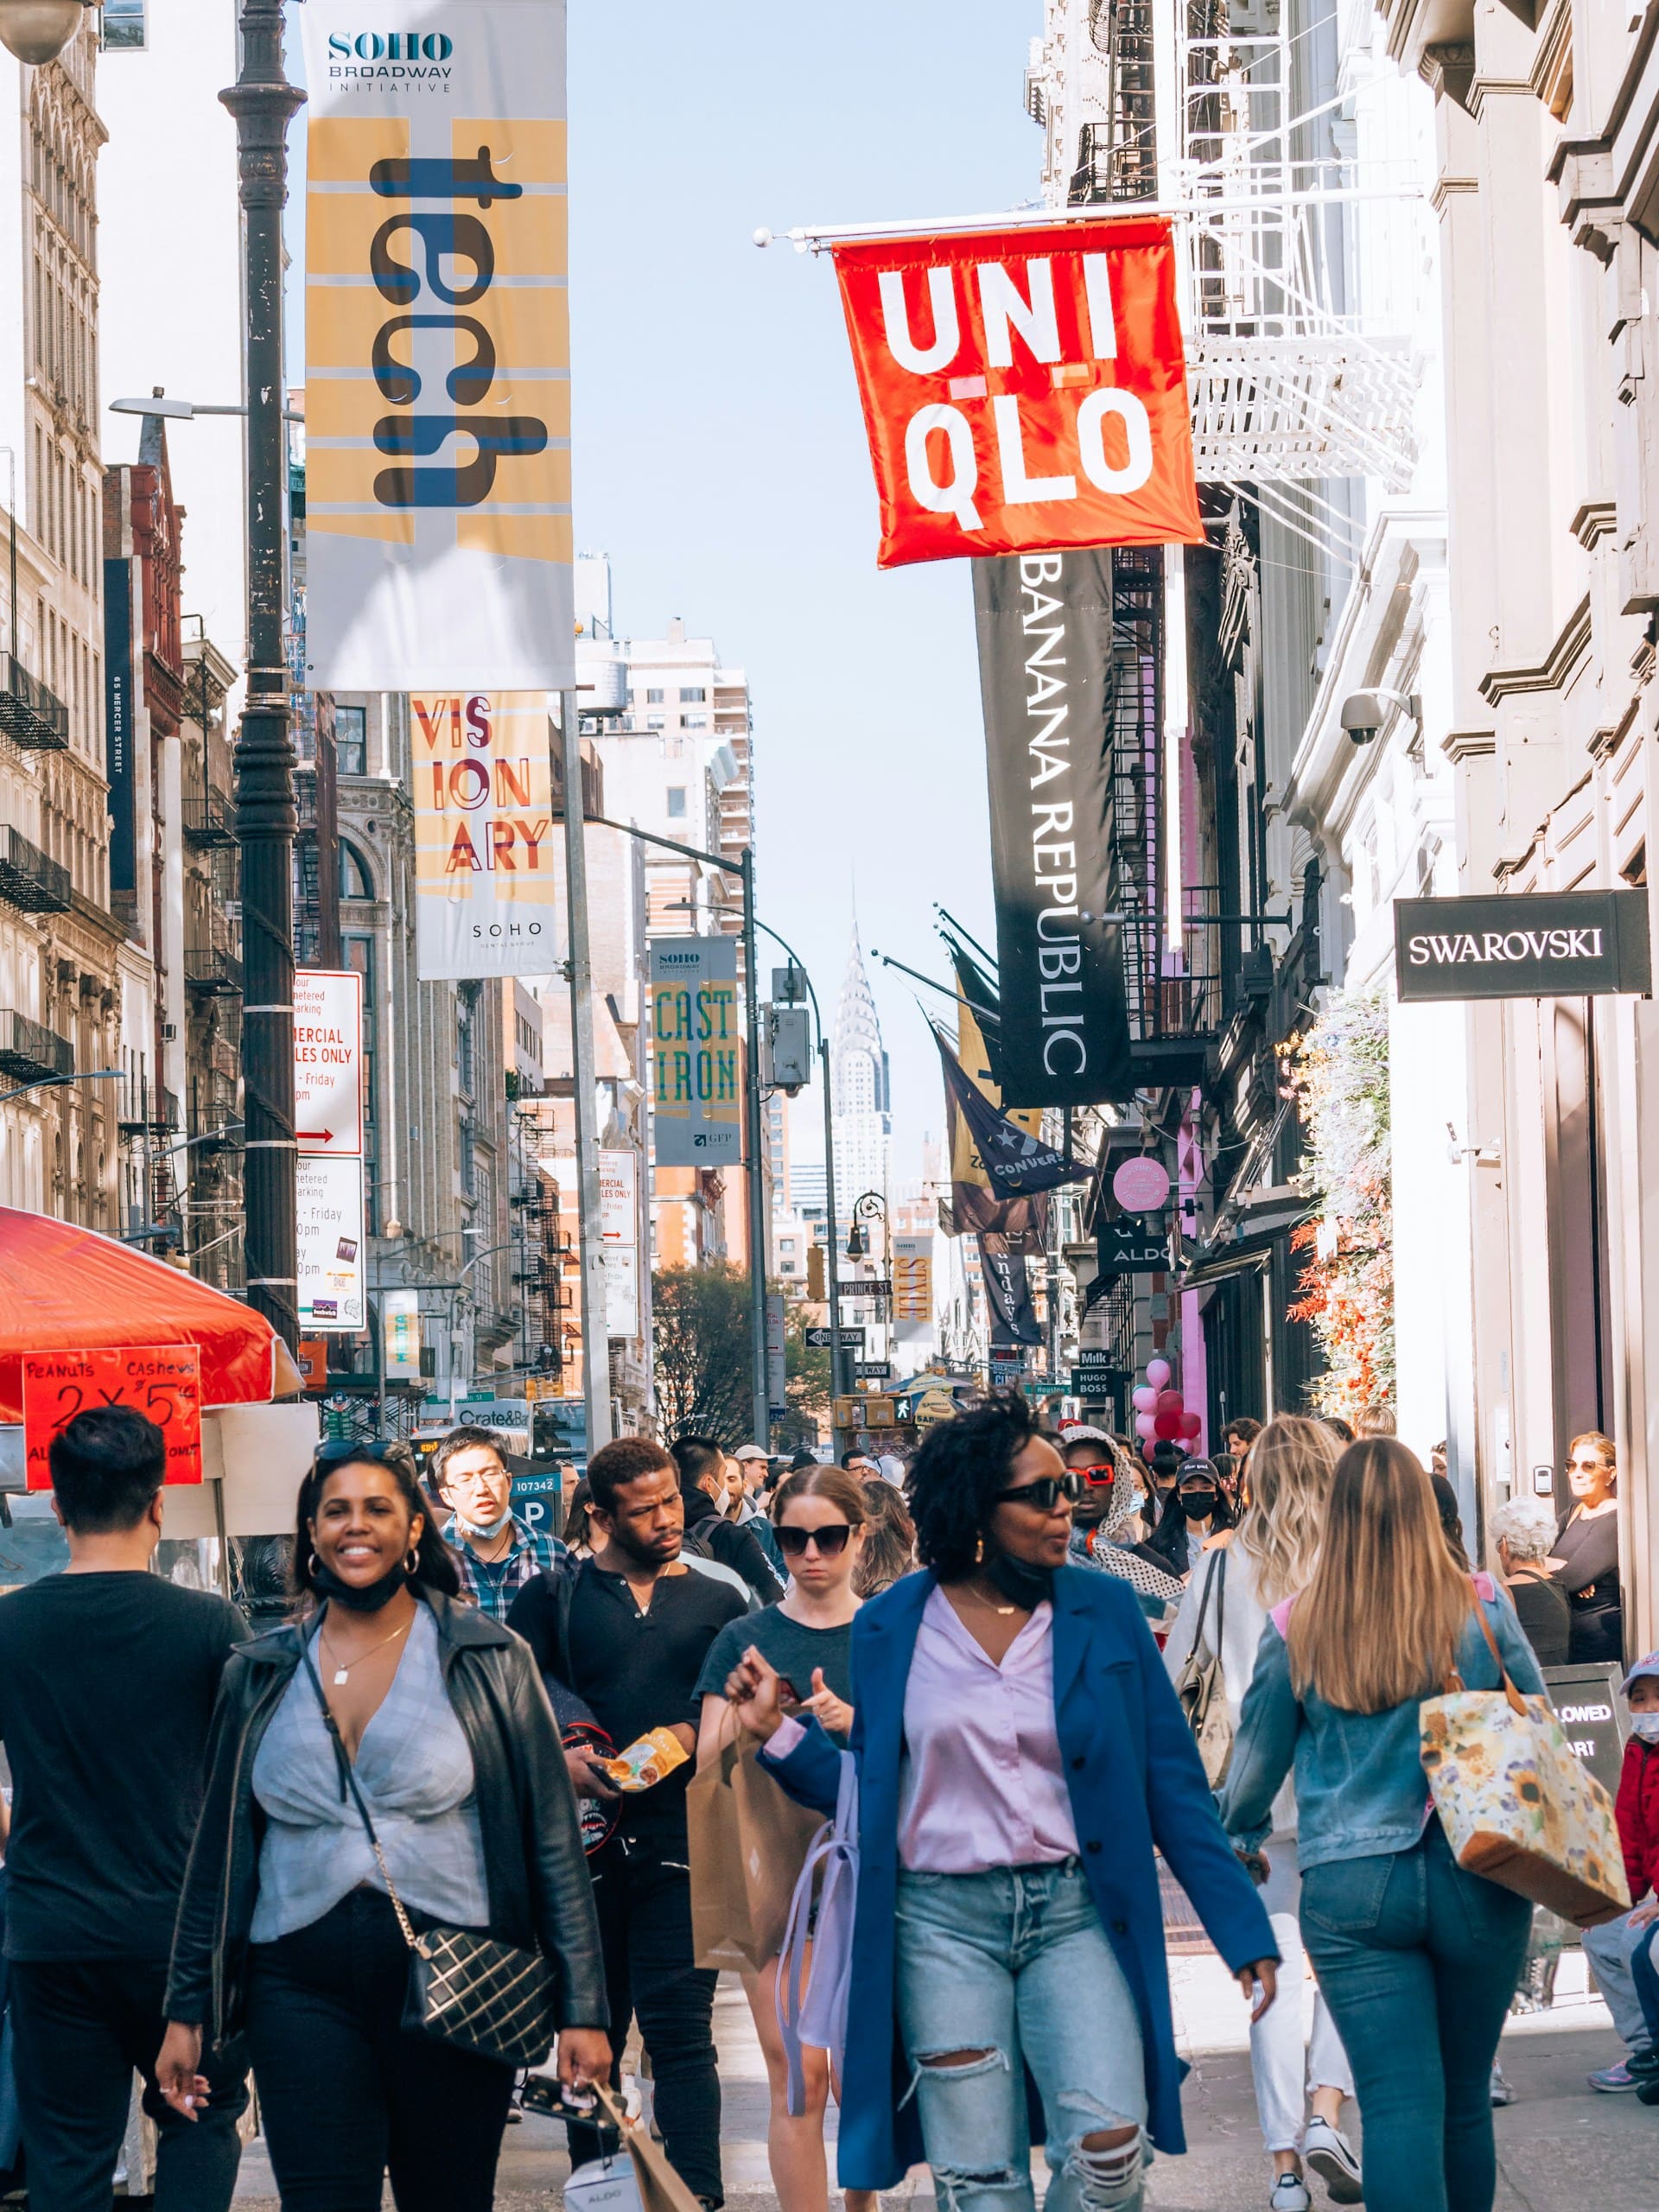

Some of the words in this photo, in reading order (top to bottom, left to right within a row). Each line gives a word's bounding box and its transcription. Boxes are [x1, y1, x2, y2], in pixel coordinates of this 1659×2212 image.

[327, 31, 454, 61] SOHO
[327, 66, 453, 79] BROADWAY
[328, 82, 452, 93] INITIATIVE
[878, 252, 1118, 375] UNI
[370, 145, 548, 508] tech
[904, 387, 1154, 532] QLO
[1019, 553, 1073, 791] BANANA
[113, 676, 121, 690] 65
[113, 692, 122, 733] MERCER
[412, 695, 493, 751] VIS
[114, 735, 123, 774] STREET
[432, 757, 531, 811] ION
[444, 818, 550, 874] ARY
[473, 922, 543, 938] SOHO
[1031, 802, 1088, 1077] REPUBLIC
[1409, 928, 1604, 966] SWAROVSKI
[659, 954, 700, 963] SOHO
[656, 989, 734, 1042] CAST
[321, 1048, 353, 1064] ONLY
[305, 1072, 335, 1089] Friday
[656, 1049, 736, 1102] IRON
[709, 1134, 732, 1143] GFP
[995, 1152, 1065, 1176] CONVERS
[614, 1190, 631, 1198] ONLY
[311, 1207, 342, 1224] Friday
[843, 1283, 874, 1295] PRINCE
[878, 1282, 889, 1294] ST
[898, 1258, 927, 1319] STYLE
[815, 1332, 831, 1342] ONE
[840, 1332, 858, 1342] WAY
[1081, 1352, 1107, 1364] Milk
[1080, 1374, 1108, 1382] HUGO
[1080, 1384, 1108, 1393] BOSS
[51, 1384, 84, 1428] 2
[459, 1409, 530, 1427] Crate&Ba
[517, 1481, 554, 1492] 107342
[524, 1502, 545, 1527] P
[588, 2190, 622, 2203] ALDO
